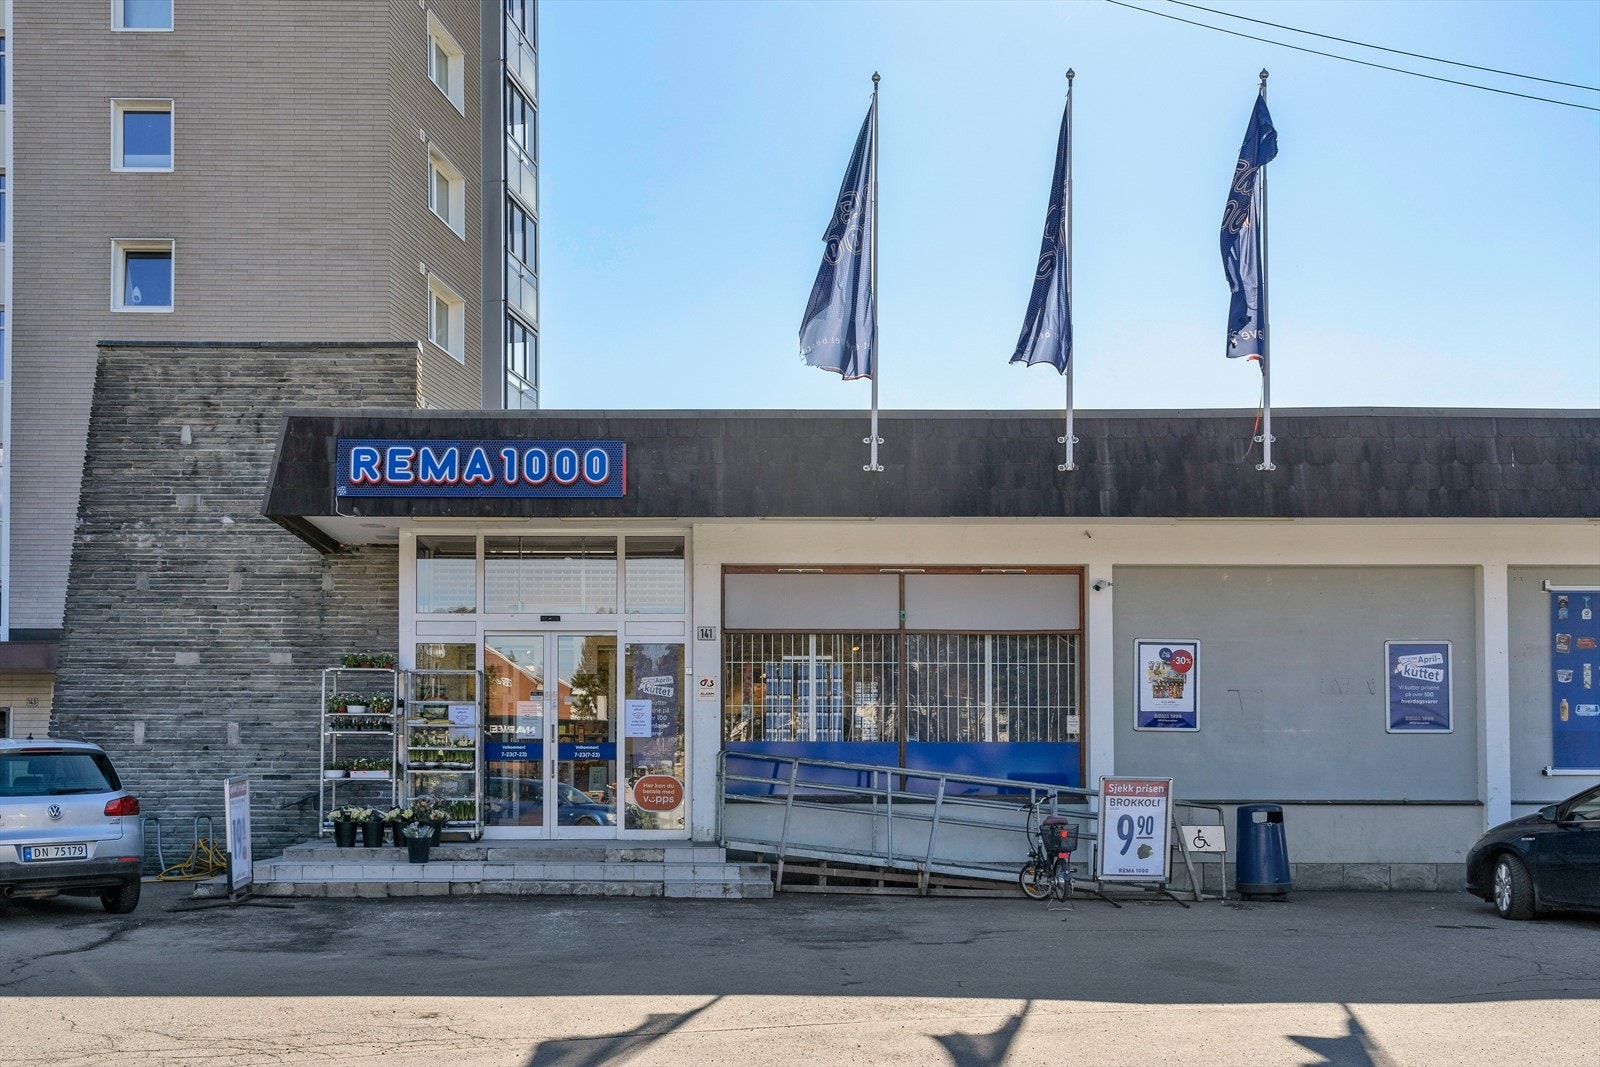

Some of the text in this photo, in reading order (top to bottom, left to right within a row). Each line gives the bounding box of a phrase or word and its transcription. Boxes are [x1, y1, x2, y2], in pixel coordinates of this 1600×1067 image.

[351, 447, 609, 483] REMA 1000
[700, 628, 713, 639] 141
[1172, 656, 1191, 665] -30%
[1418, 655, 1441, 664] April-
[1403, 664, 1440, 681] kuttet
[644, 683, 672, 697] kuttet
[1108, 784, 1164, 795] Sjekk prisen
[1110, 798, 1160, 807] BROKKOLI
[1117, 814, 1154, 856] 9 90
[34, 846, 83, 858] DN 75179
